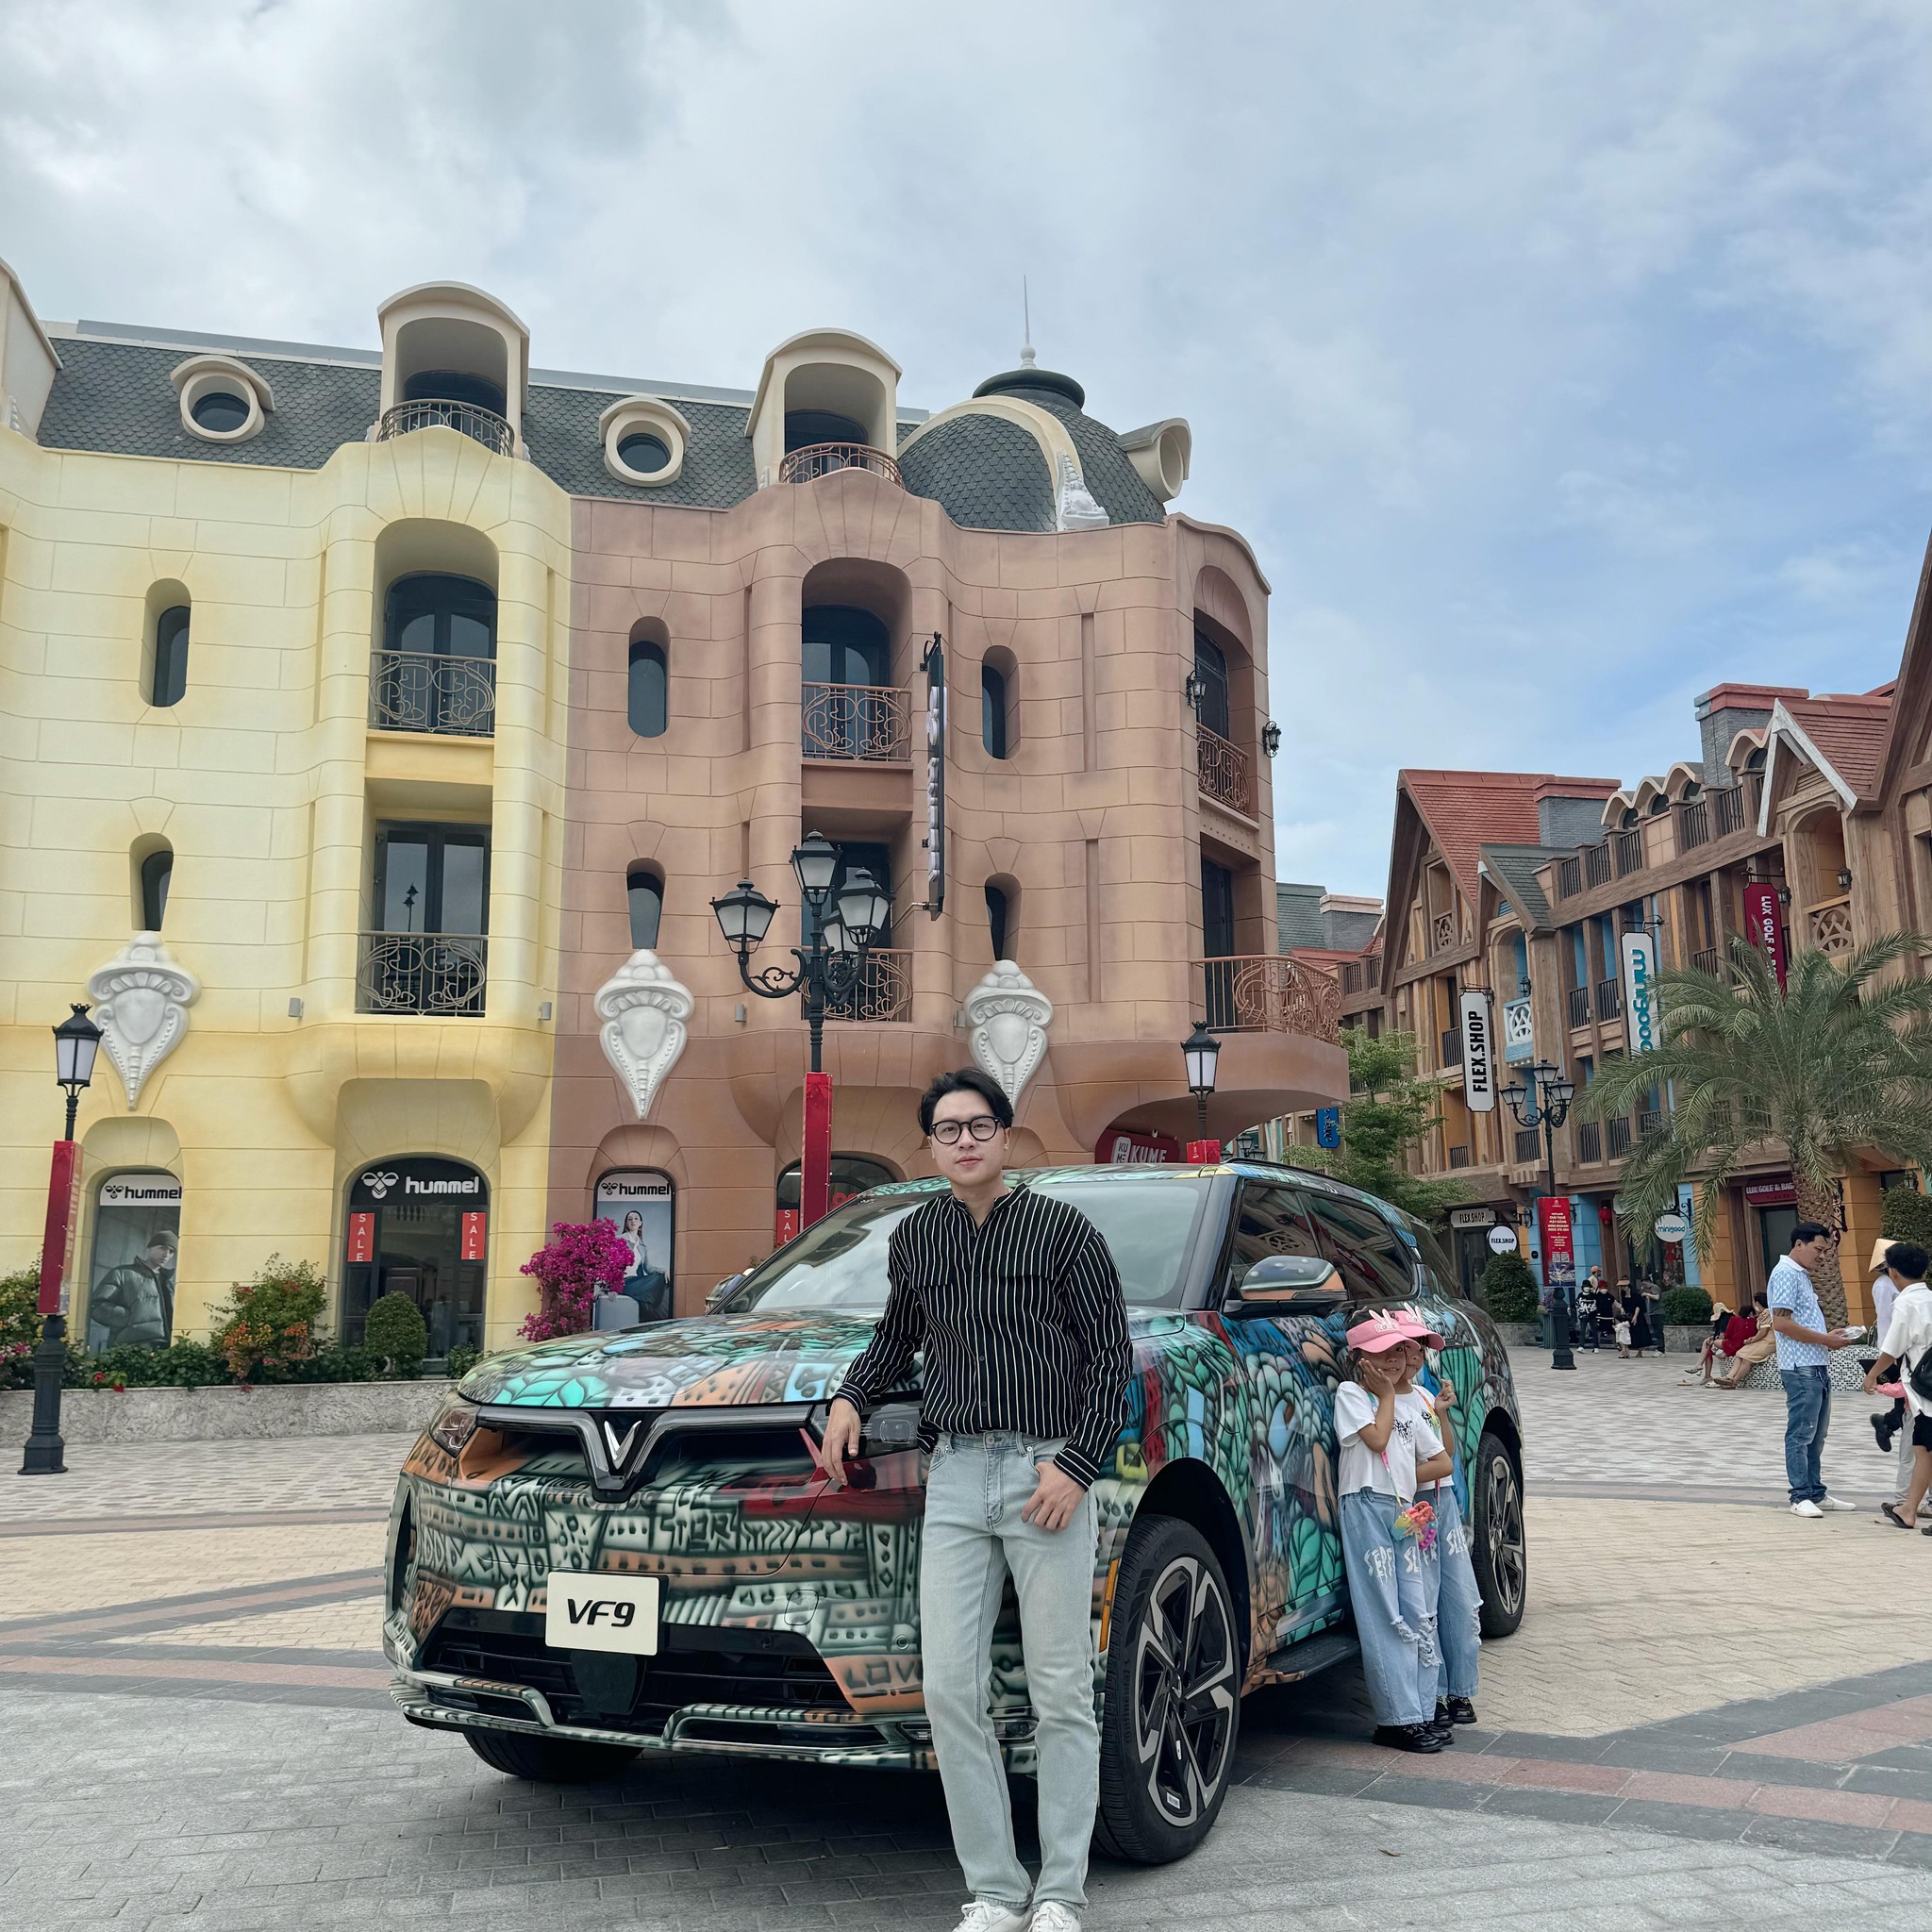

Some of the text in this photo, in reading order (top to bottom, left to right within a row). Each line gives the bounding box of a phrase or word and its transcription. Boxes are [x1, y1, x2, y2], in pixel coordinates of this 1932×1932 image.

[1760, 895, 1773, 915] LUX
[1762, 918, 1774, 944] GOLF
[1468, 1010, 1488, 1092] FLEX.SHOP
[124, 1185, 183, 1199] hummel
[405, 1175, 480, 1194] hummel
[619, 1182, 670, 1195] hummel
[1459, 1211, 1485, 1224] FLEX.SHOP
[356, 1213, 366, 1262] SALE
[469, 1212, 477, 1260] SALE
[1657, 1225, 1686, 1234] minigood
[567, 1598, 636, 1627] VF9
